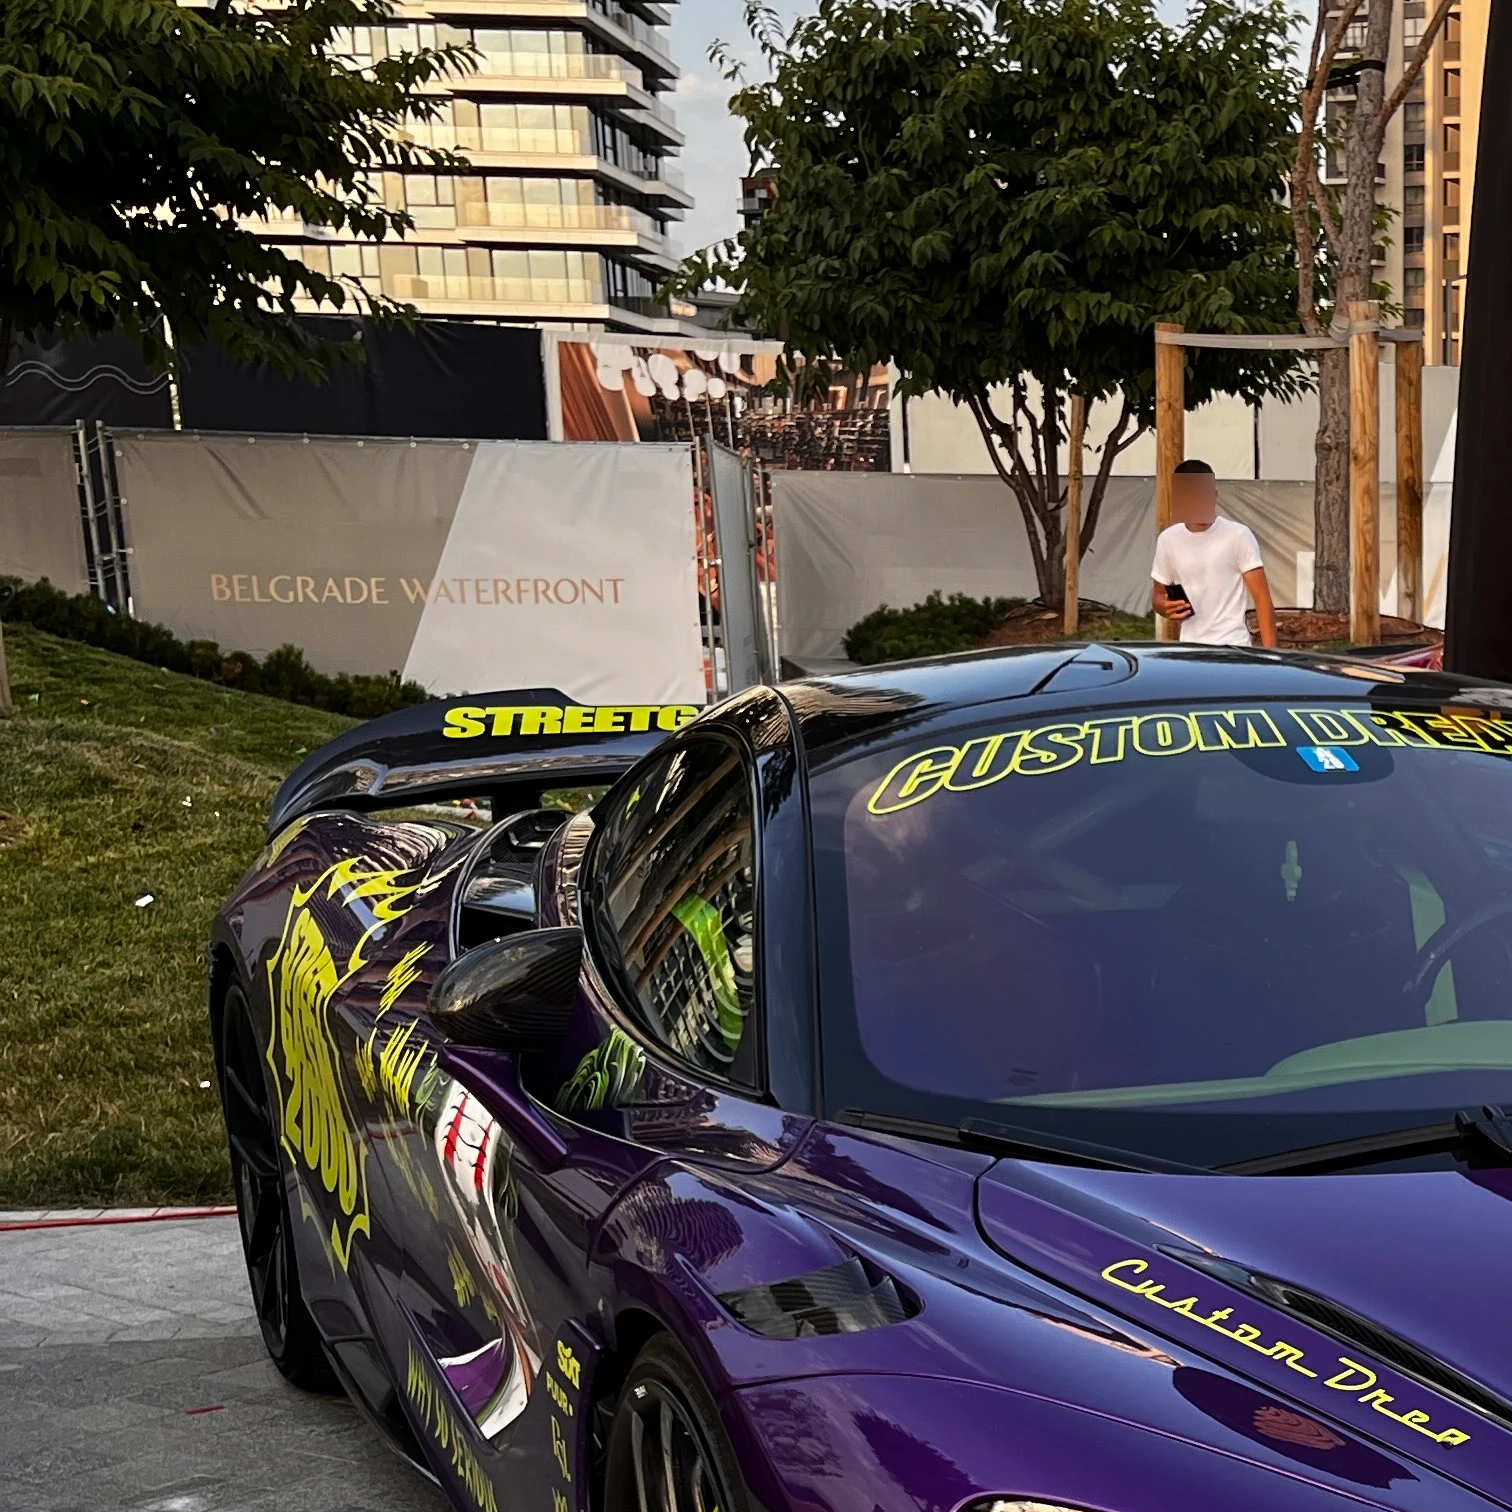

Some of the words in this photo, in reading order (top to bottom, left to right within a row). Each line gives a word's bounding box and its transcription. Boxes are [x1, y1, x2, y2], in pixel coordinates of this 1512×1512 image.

[211, 574, 389, 605] BELGRADE
[400, 577, 625, 605] WATERFRONT
[868, 709, 1288, 816] CUSTOM
[285, 1056, 358, 1216] 2000
[1101, 1258, 1318, 1379] Custom
[406, 1337, 433, 1433] WHY
